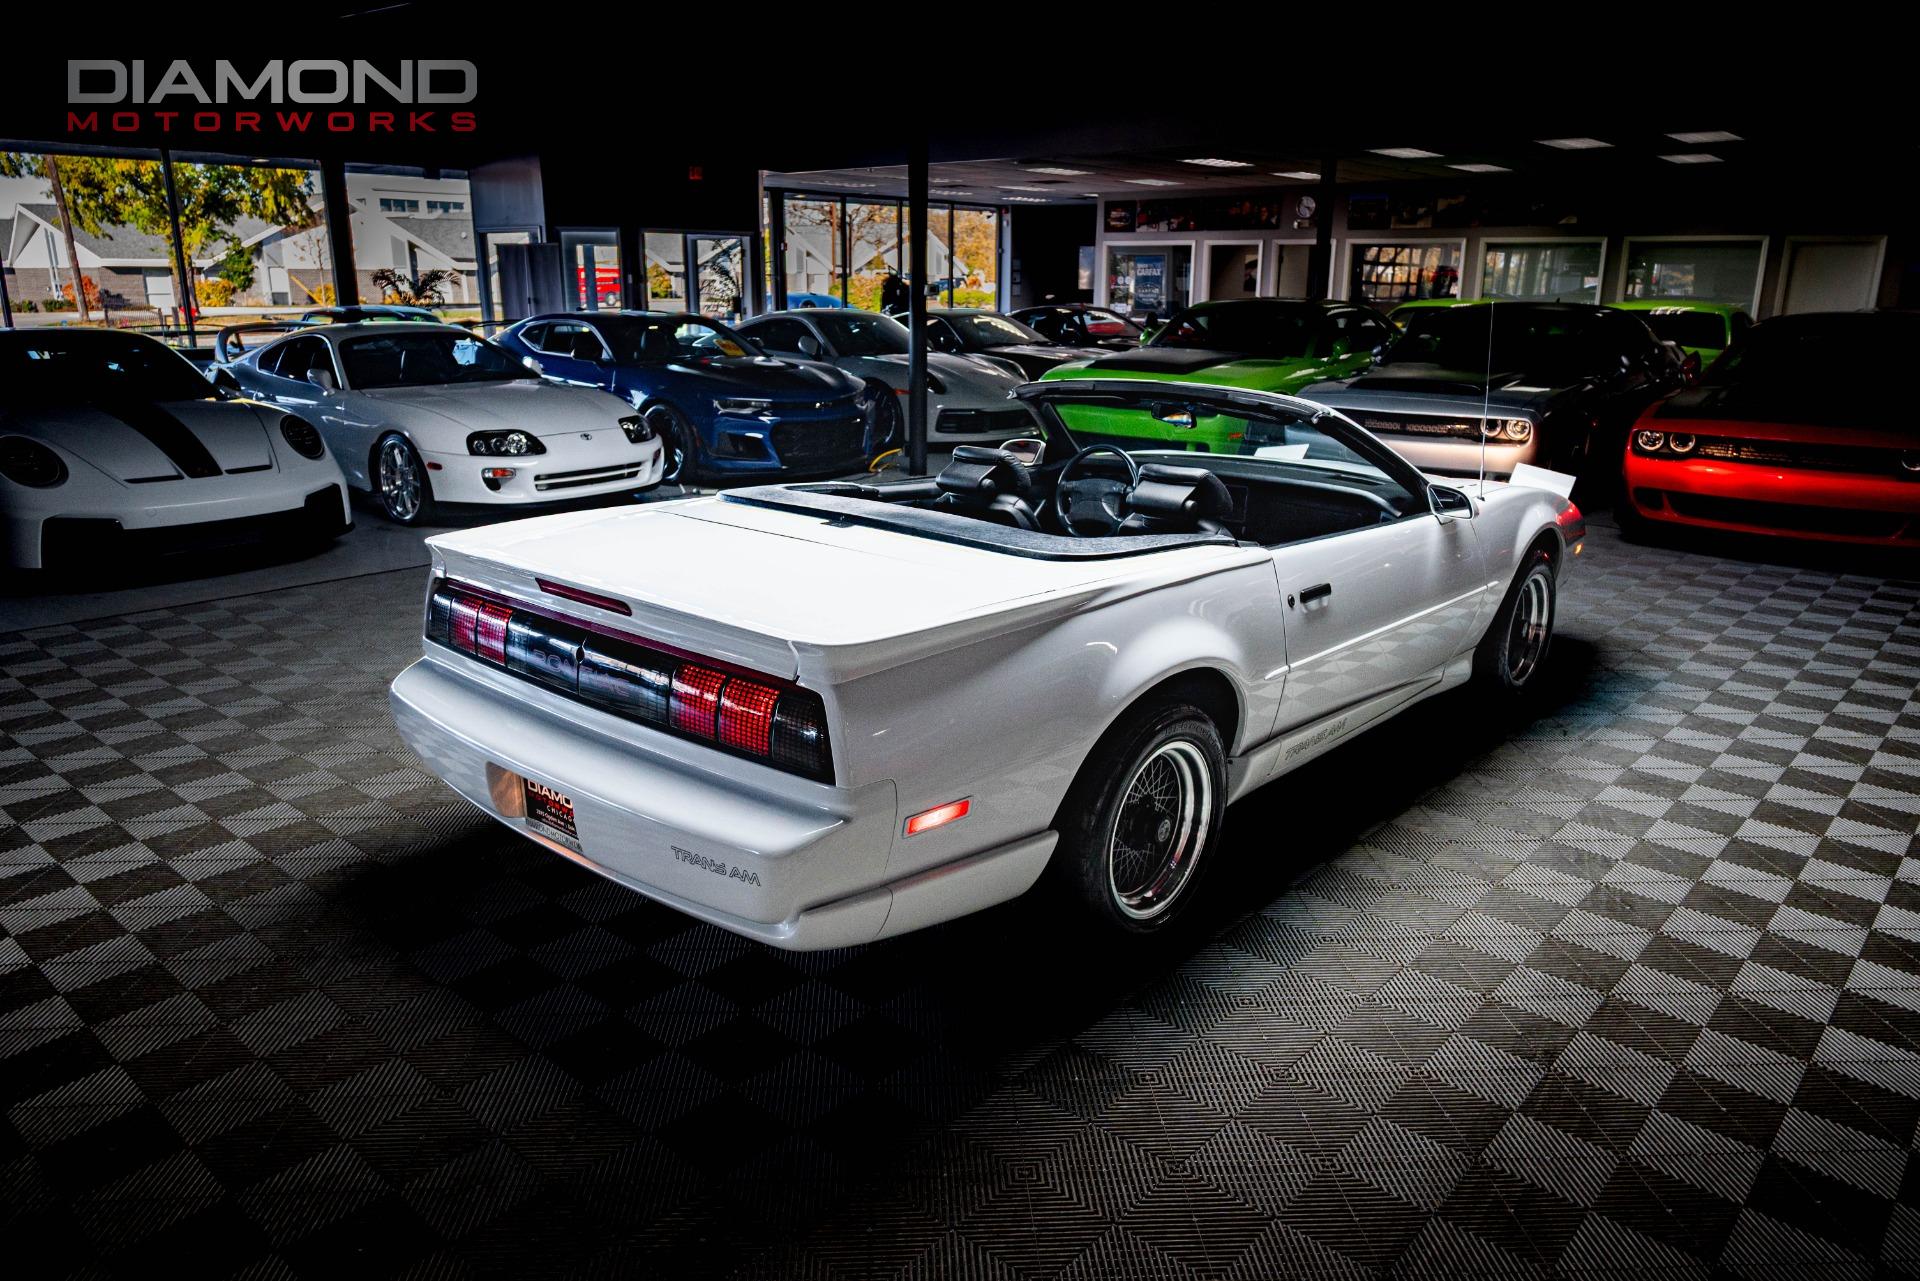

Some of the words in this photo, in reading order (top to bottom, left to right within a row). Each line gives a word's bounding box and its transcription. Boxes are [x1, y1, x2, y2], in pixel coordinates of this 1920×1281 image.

[1136, 268, 1161, 277] CARFAX
[670, 845, 727, 876] TRANS
[728, 866, 761, 887] AM
